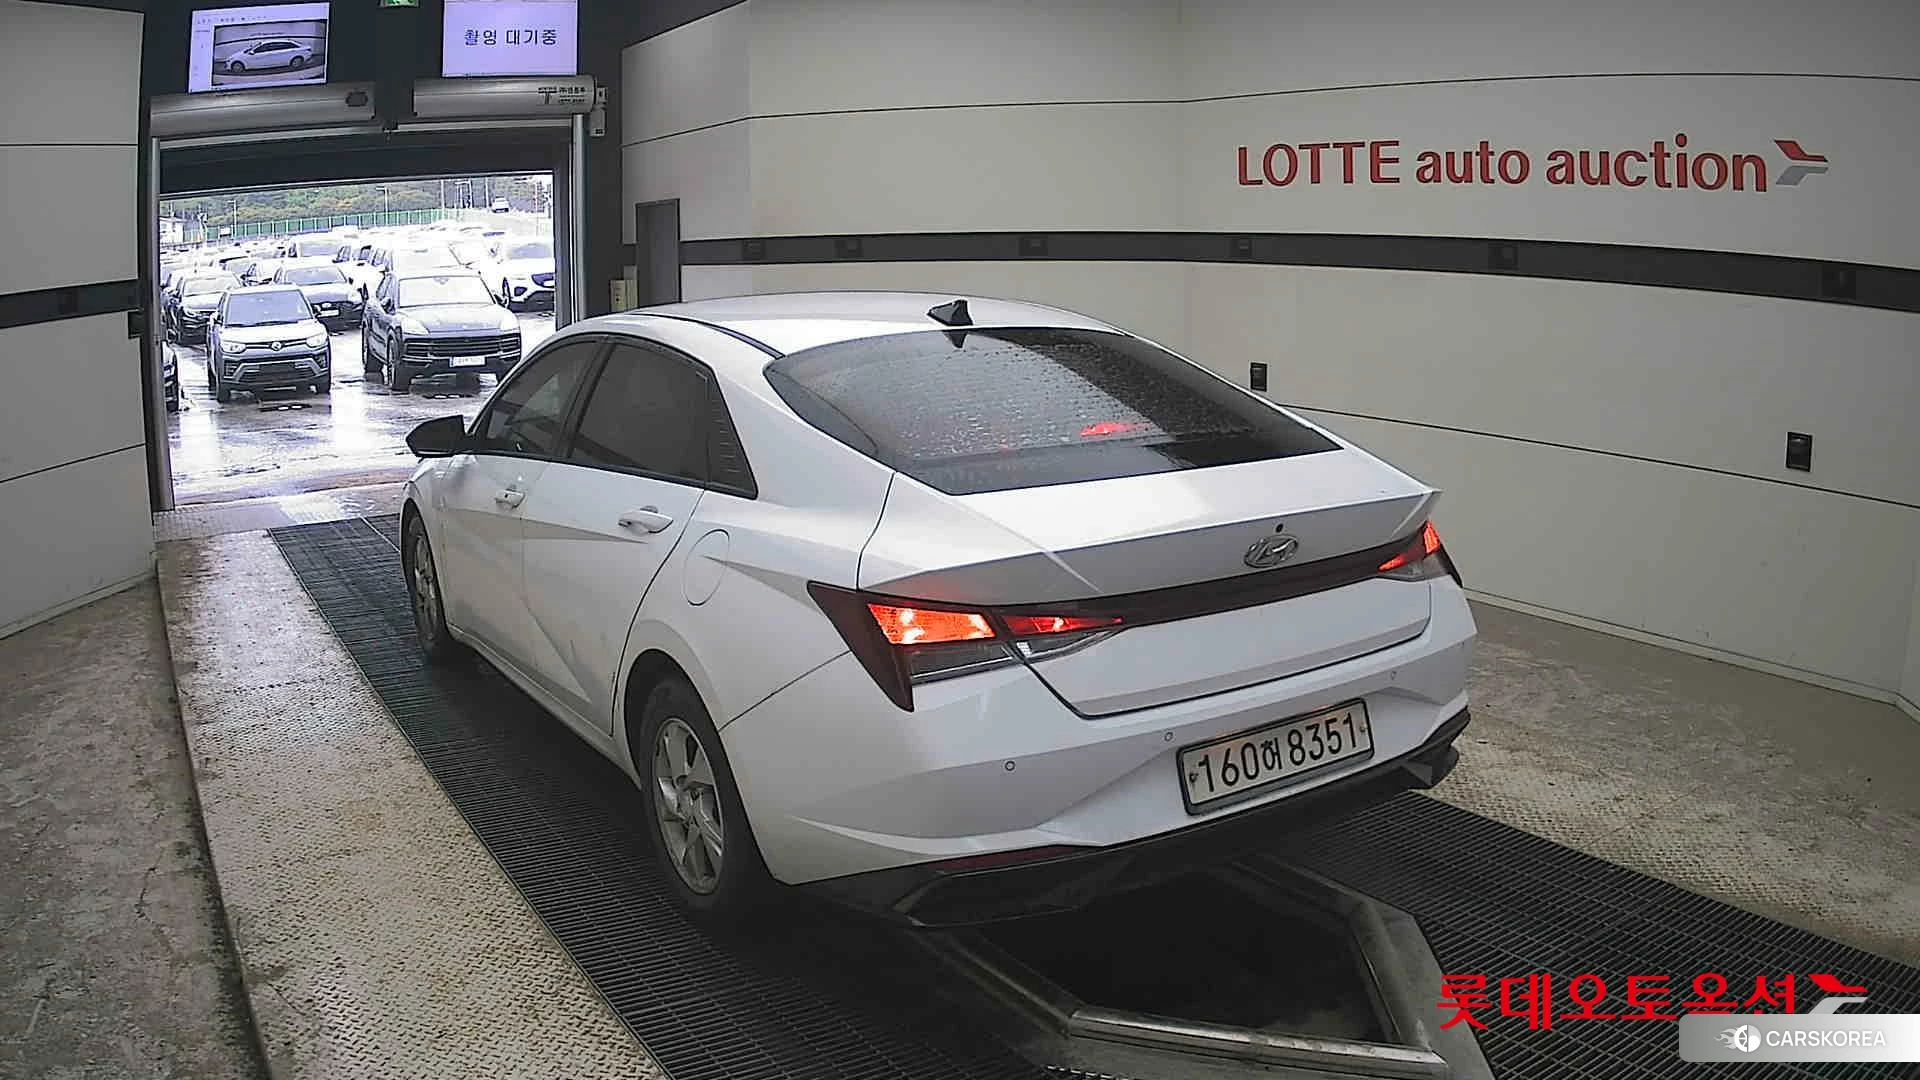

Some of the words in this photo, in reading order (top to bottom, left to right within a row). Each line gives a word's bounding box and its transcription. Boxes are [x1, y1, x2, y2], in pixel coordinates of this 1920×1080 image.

[464, 29, 497, 46] 촬영
[506, 29, 557, 46] 대기중
[1237, 139, 1400, 186] LOTTE
[1415, 140, 1531, 185] auto
[1545, 133, 1769, 193] auction
